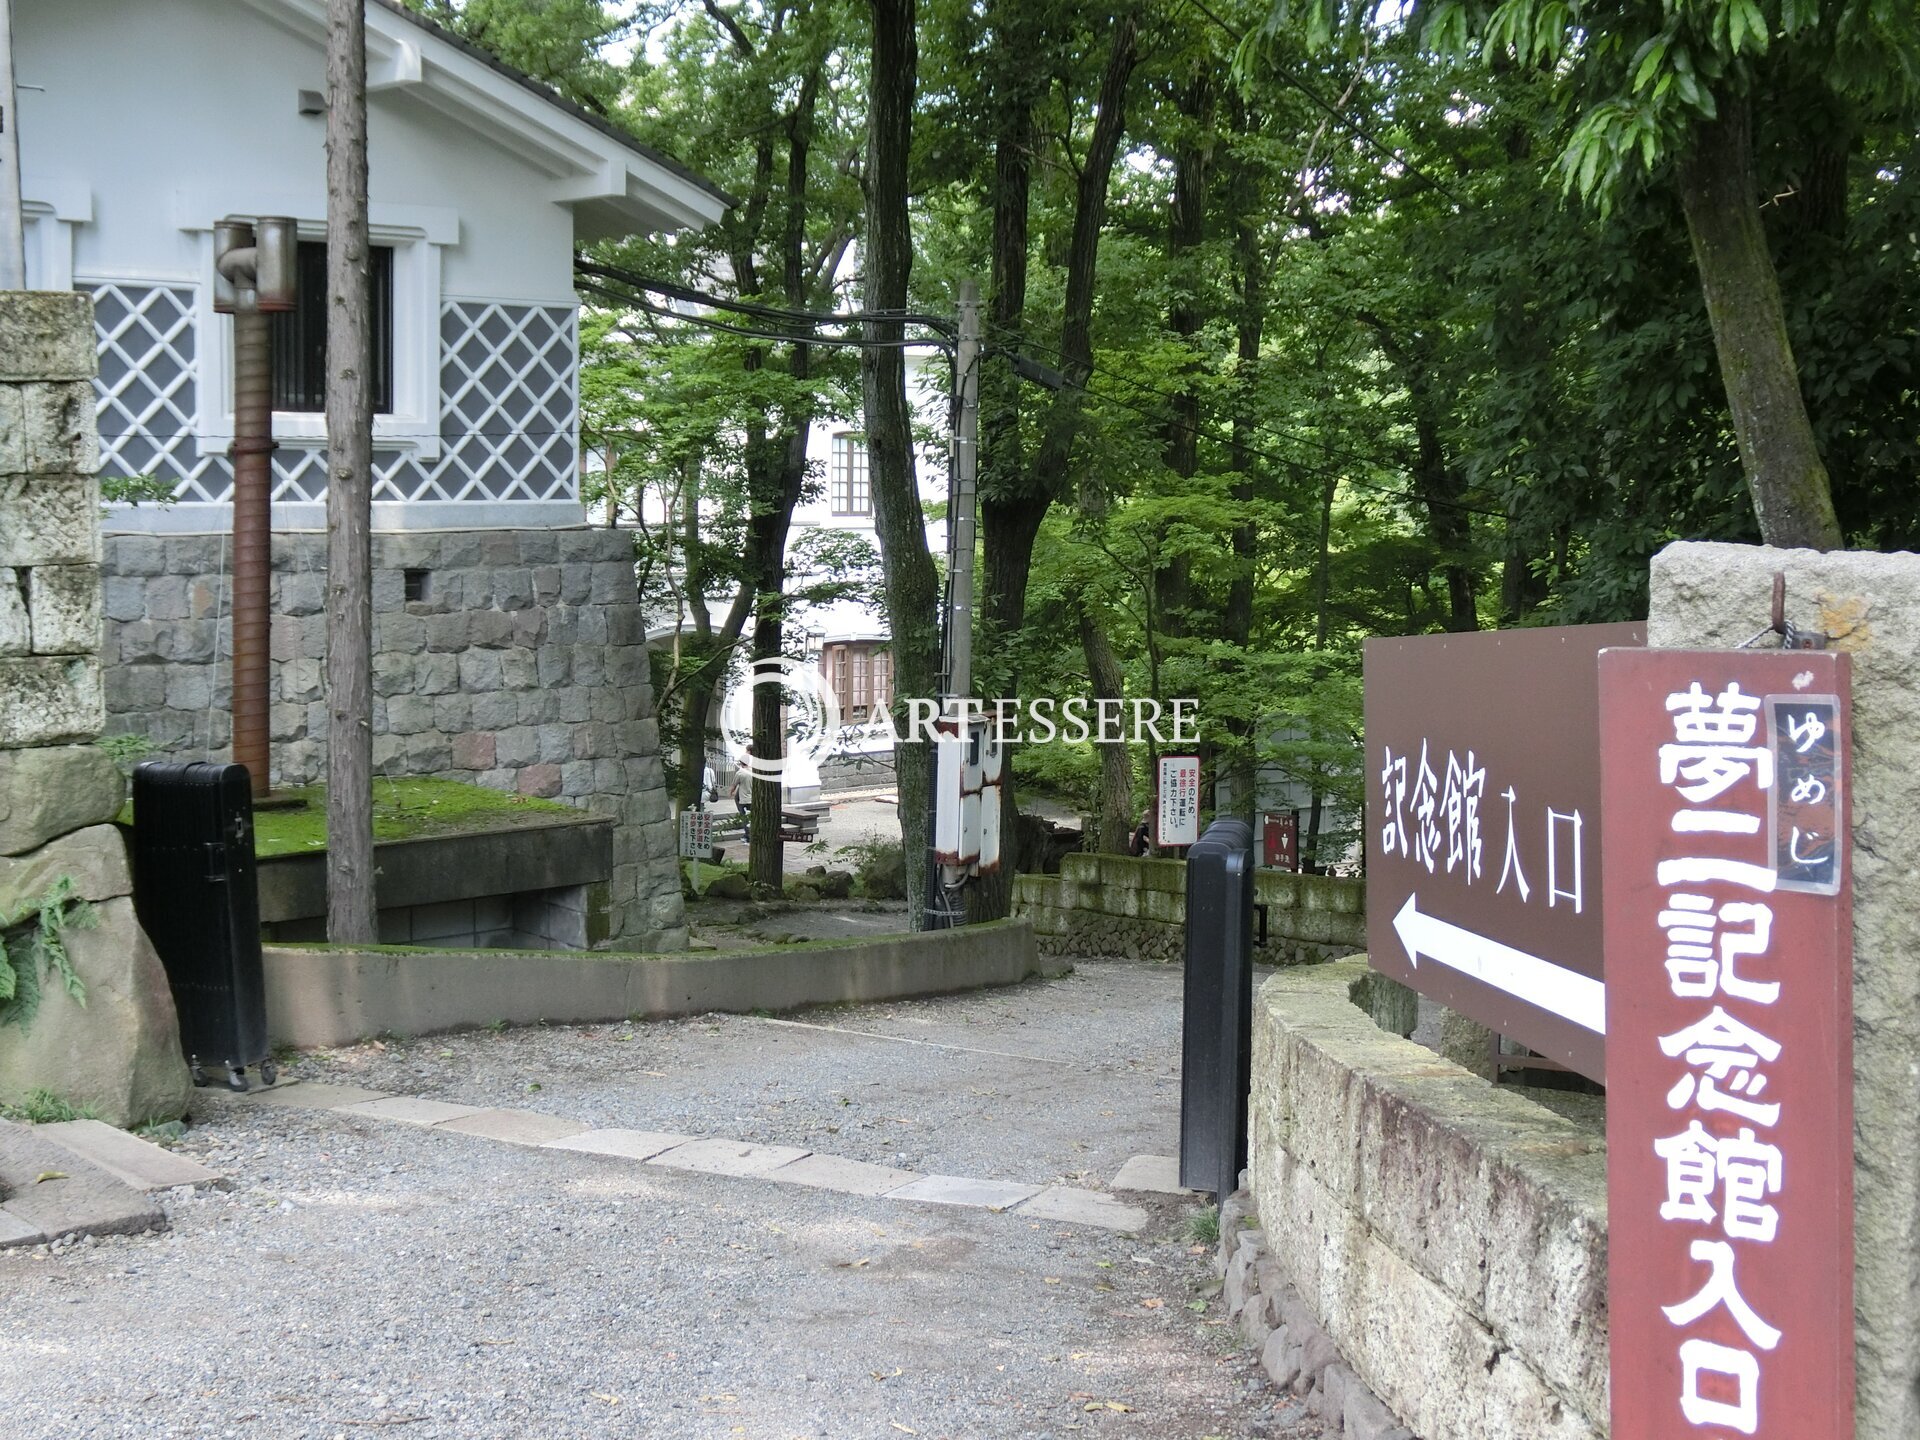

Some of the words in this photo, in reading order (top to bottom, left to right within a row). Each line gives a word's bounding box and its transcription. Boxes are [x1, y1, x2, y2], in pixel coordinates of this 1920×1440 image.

[1382, 737, 1583, 914] 記念館入口
[1788, 712, 1829, 864] ゆめじ
[1654, 682, 1783, 1434] 夢二記念館入口
